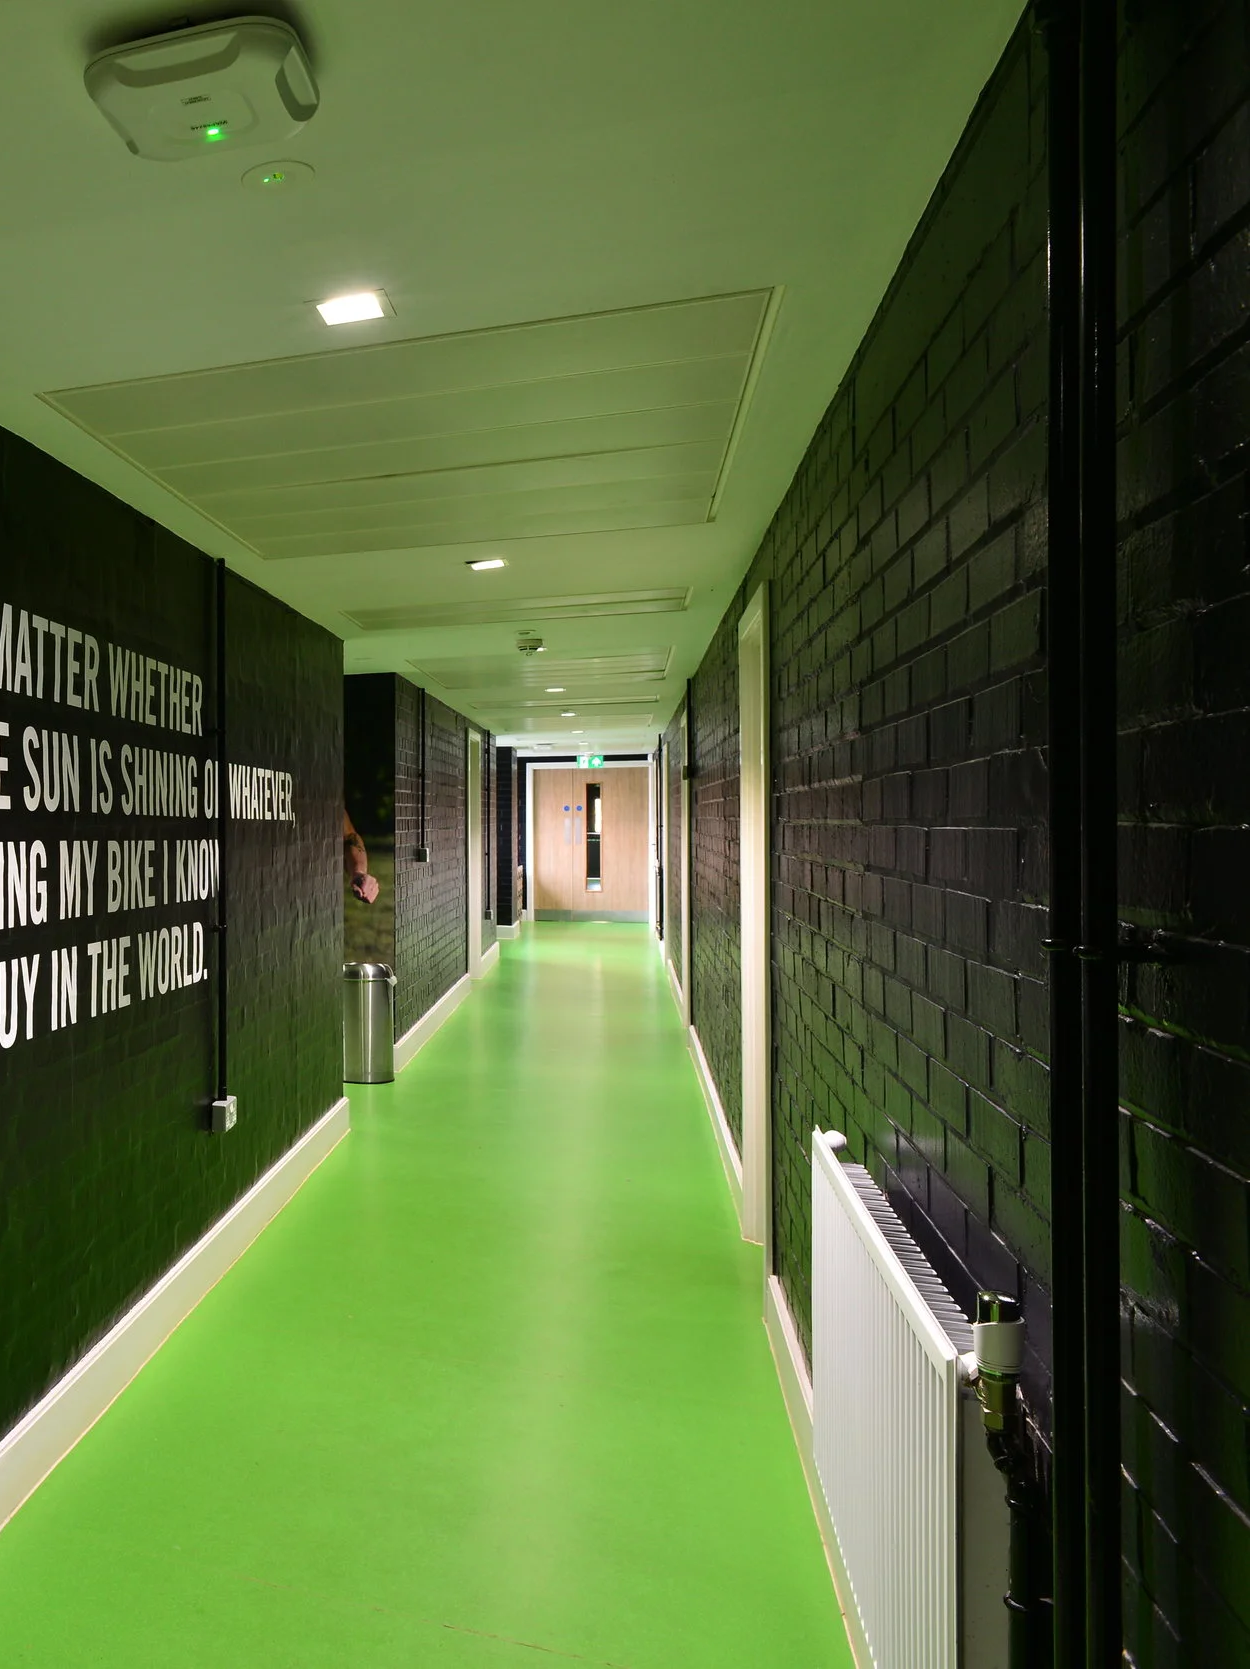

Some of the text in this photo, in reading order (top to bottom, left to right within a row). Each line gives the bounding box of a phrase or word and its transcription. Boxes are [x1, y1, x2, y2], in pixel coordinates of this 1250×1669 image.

[109, 643, 202, 736] WHETHER
[23, 726, 79, 812] SUN
[90, 739, 113, 814] IS
[121, 744, 197, 818] SHINING
[229, 763, 296, 828] WHATEVER,
[60, 840, 98, 920] MY
[108, 840, 155, 913] BIKE
[163, 840, 169, 904] I
[51, 946, 77, 1031] IN
[88, 936, 131, 1018] THE
[138, 922, 208, 1000] WORLD.
